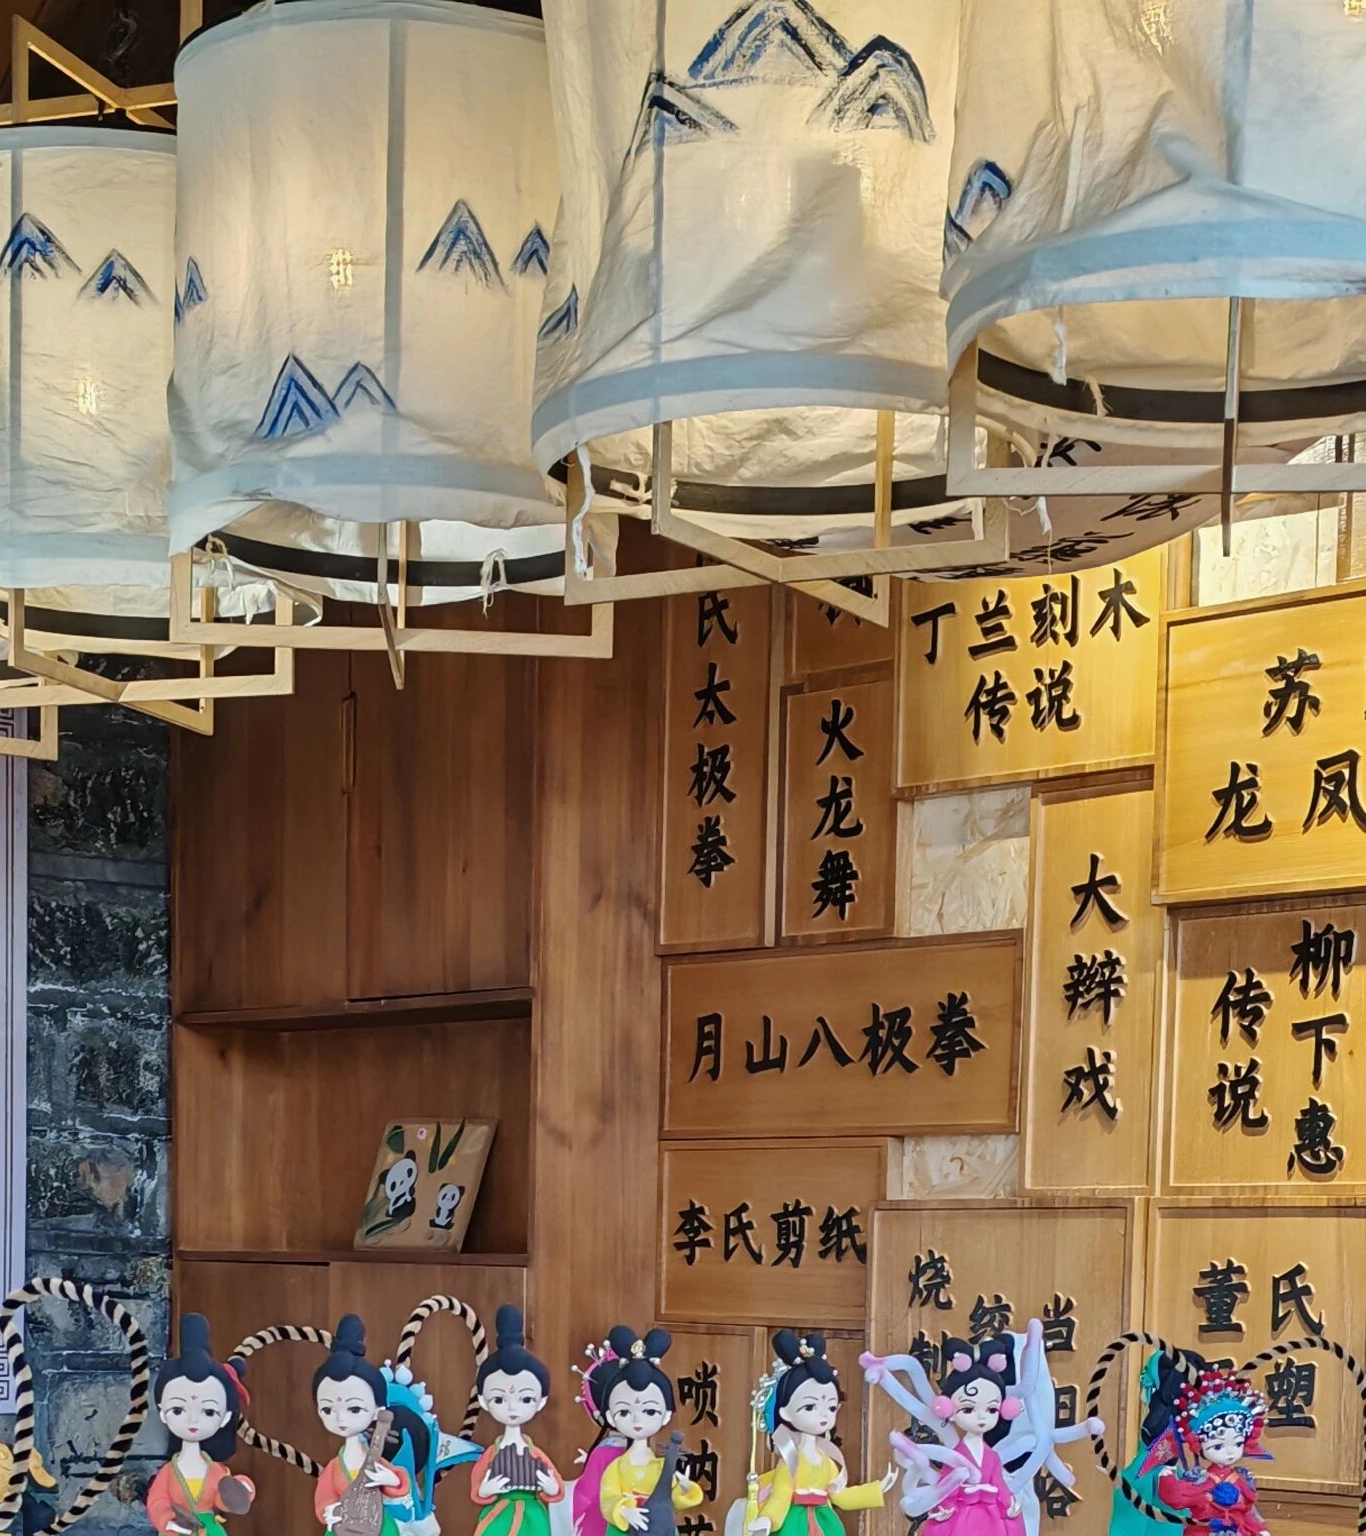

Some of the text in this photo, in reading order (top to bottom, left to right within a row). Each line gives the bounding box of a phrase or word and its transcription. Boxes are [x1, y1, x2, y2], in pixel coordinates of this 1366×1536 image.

[910, 567, 1150, 666] 丁兰刻木
[685, 553, 738, 889] 氏太极拳
[965, 660, 1081, 744] 传说
[810, 698, 864, 920] 火龙舞
[688, 992, 985, 1083] 月山八极拳
[1207, 966, 1272, 1133] 传说
[1287, 920, 1356, 1178] 柳下惠
[672, 1199, 868, 1269] 李氏剪纸
[1192, 1257, 1325, 1336] 董氏
